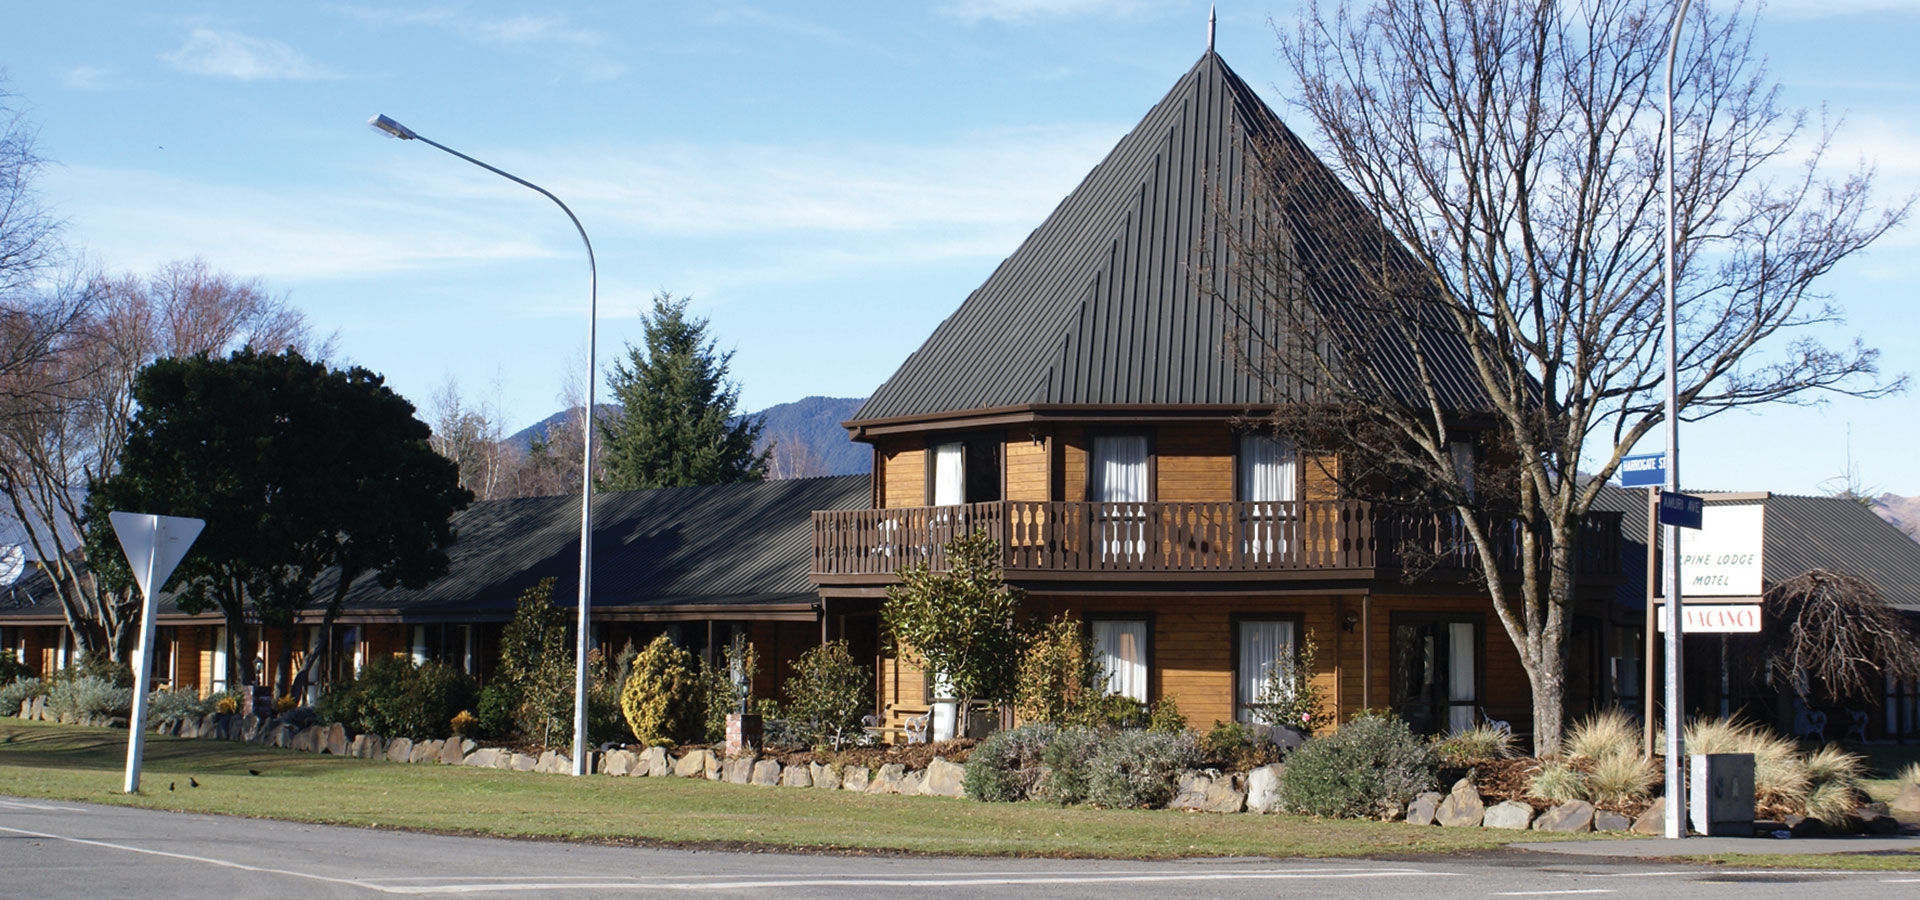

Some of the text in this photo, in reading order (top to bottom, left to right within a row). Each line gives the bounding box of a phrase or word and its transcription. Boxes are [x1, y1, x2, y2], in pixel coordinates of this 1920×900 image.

[1623, 458, 1656, 472] HARROGATE
[1663, 496, 1701, 514] AMURI AVE
[1717, 553, 1755, 566] LODGE
[1693, 575, 1730, 586] MOTEL
[1686, 610, 1755, 627] VACANCY
